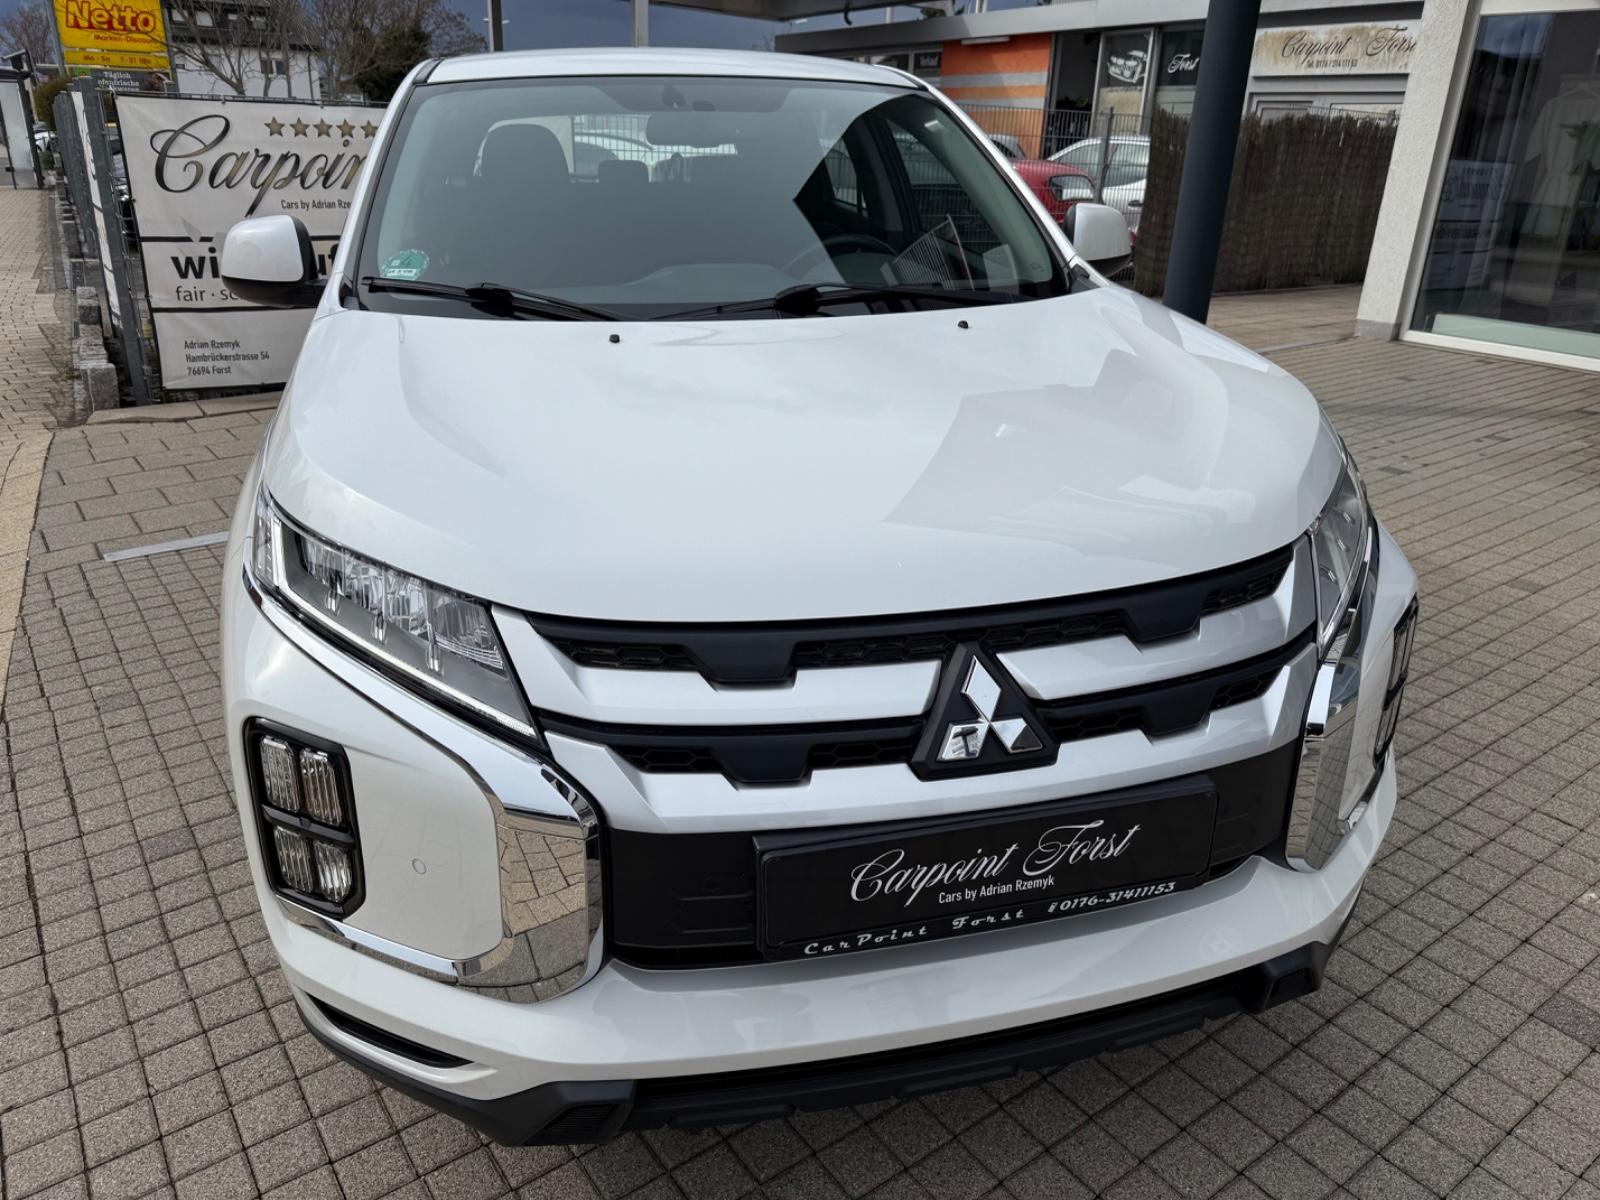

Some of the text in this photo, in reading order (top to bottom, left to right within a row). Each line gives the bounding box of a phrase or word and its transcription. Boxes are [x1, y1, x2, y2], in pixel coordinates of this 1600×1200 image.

[66, 0, 156, 33] Netto
[1281, 31, 1352, 64] Carpoint
[280, 199, 299, 209] Cars
[300, 199, 310, 212] by
[312, 199, 336, 209] Adrian
[176, 285, 206, 302] fair
[184, 339, 241, 351] Adrian Rzemyk
[186, 350, 270, 363] Hambrückerstrasse 54
[186, 365, 233, 377] 76694 Forst
[850, 819, 1141, 907] Carpoint Forst
[939, 874, 1055, 904] Cars by Adrian Rzemyk
[952, 909, 1024, 930] Forst
